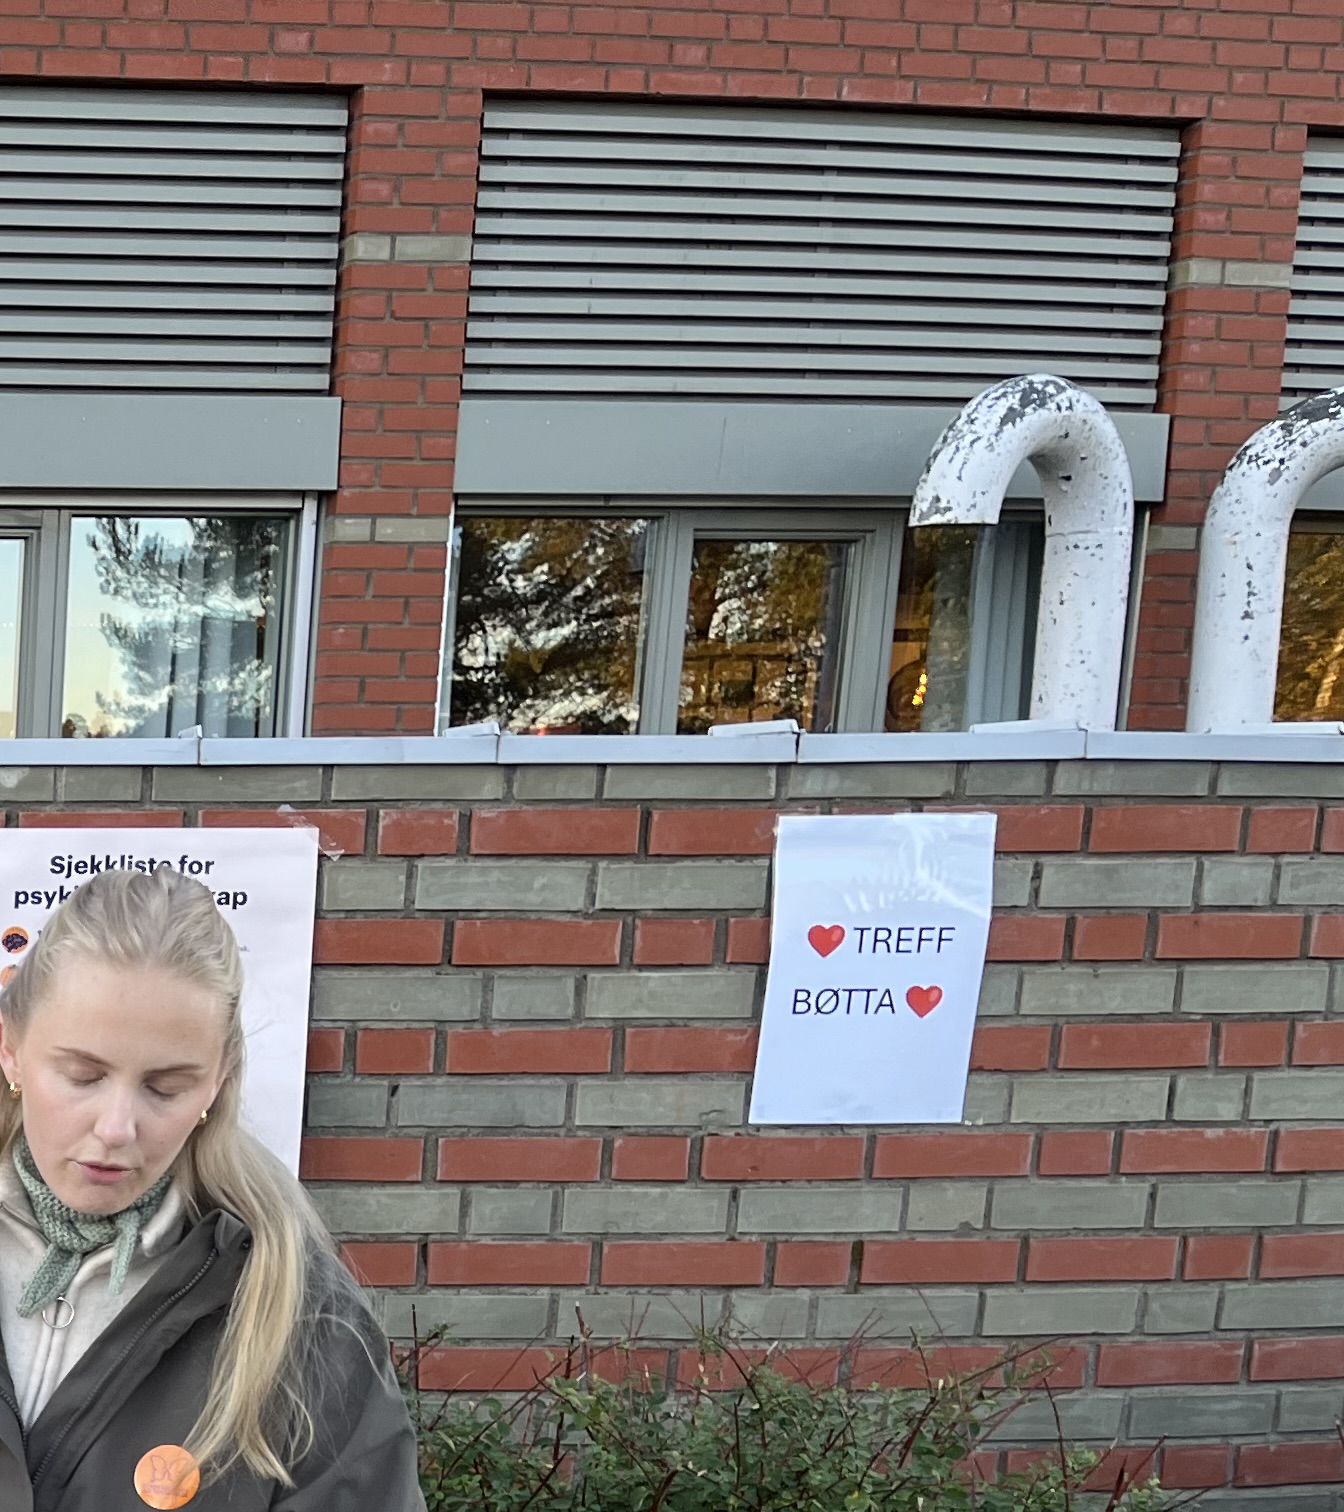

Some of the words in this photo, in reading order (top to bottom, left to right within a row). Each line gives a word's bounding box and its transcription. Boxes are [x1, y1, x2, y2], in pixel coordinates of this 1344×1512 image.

[178, 855, 215, 875] for
[14, 885, 79, 909] psyk
[853, 926, 955, 954] TREFF
[791, 986, 896, 1016] BØTTA
